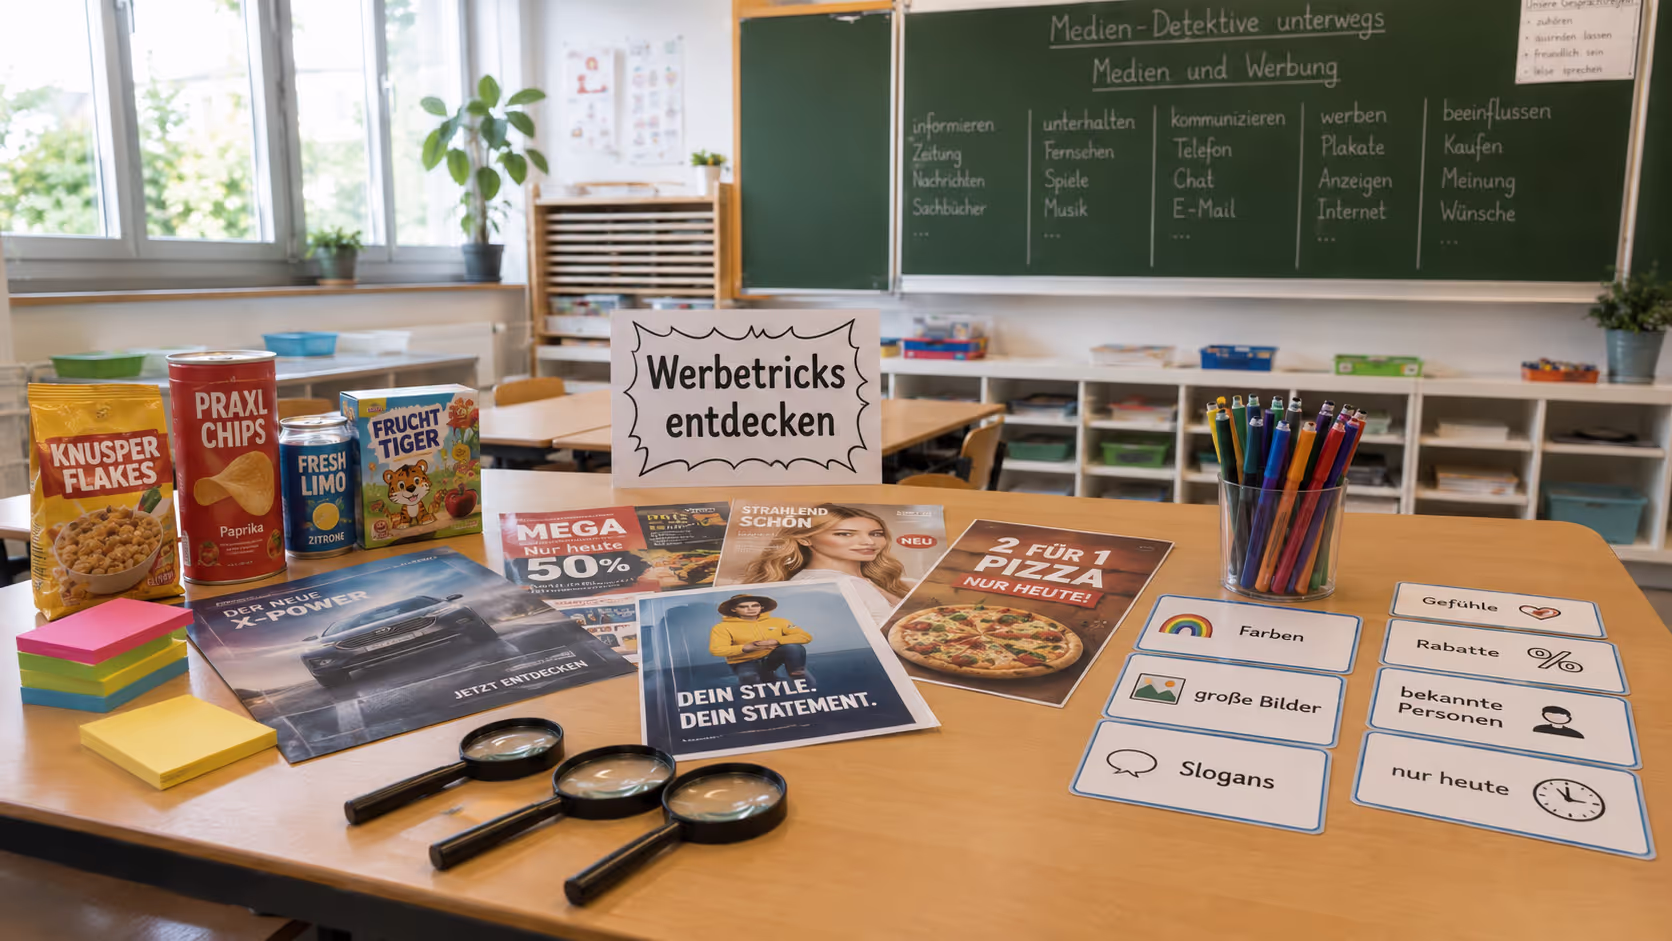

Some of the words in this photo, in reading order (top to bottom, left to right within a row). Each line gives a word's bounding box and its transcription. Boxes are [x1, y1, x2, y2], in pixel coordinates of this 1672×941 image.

[1277, 4, 1385, 40] unterwegs
[1586, 48, 1604, 56] sein
[1093, 57, 1170, 84] Medien
[1187, 53, 1228, 80] und
[1246, 51, 1338, 88] Werbung
[1043, 109, 1136, 131] unterhalten
[1171, 105, 1286, 128] kommunizieren
[1320, 101, 1387, 124] werben
[1443, 97, 1552, 130] beeinflussen
[912, 112, 995, 140] informieren
[912, 144, 962, 168] Zeitung
[1172, 136, 1232, 165] Telefon
[1321, 133, 1385, 156] Plakate
[1444, 132, 1503, 162] Kaufen
[912, 169, 985, 188] Nachrichten
[1044, 168, 1089, 194] Spiele
[1173, 167, 1215, 189] Chat
[1318, 167, 1393, 198] Anzeigen
[1442, 167, 1516, 198] Meinung
[912, 198, 987, 216] Sachbücher
[1044, 198, 1088, 217] Musik
[1173, 198, 1236, 218] E-Mail
[1317, 199, 1387, 220] Internet
[1440, 200, 1516, 222] Wünsche
[646, 353, 846, 390] Werbetricks
[195, 388, 268, 419] PRAXL
[372, 408, 440, 439] FRUCHT
[666, 401, 835, 437] entdecken
[201, 418, 266, 448] CHIPS
[378, 428, 440, 459] TIGER
[50, 436, 160, 467] KNUSPER
[298, 451, 347, 473] FRESH
[62, 461, 157, 494] FLAKES
[301, 471, 346, 496] LIMO
[738, 515, 812, 529] SCHÖN
[742, 505, 829, 516] STRAHLEND
[220, 522, 264, 539] Paprika
[308, 532, 345, 545] ZITRONE
[517, 518, 627, 541] MEGA
[901, 537, 933, 545] NEU
[523, 545, 561, 556] Nur
[567, 541, 623, 553] heute
[989, 537, 1020, 553] 2
[1025, 543, 1084, 565] FÜR
[1093, 550, 1112, 566] 1
[527, 554, 631, 581] 50%
[973, 555, 1103, 588] PIZZA
[963, 576, 1010, 591] NUR
[1013, 583, 1092, 604] HEUTE!
[223, 604, 265, 618] DER
[269, 591, 322, 608] NEUE
[230, 590, 371, 630] X-POWER
[1422, 596, 1498, 612] Gefühle
[1239, 625, 1304, 642] Farben
[1416, 639, 1500, 658] Rabatte
[453, 681, 498, 700] JETZT
[500, 659, 589, 687] ENTDECKEN
[677, 687, 734, 708] DEIN
[739, 678, 817, 700] STYLE.
[1194, 690, 1253, 706] große
[1259, 695, 1322, 714] Bilder
[1400, 686, 1504, 711] bekannte
[679, 710, 737, 730] DEIN
[743, 691, 877, 723] STATEMENT.
[1398, 702, 1503, 729] Personen
[1179, 760, 1275, 789] Slogans
[1391, 766, 1432, 782] nur
[1440, 771, 1510, 796] heute
